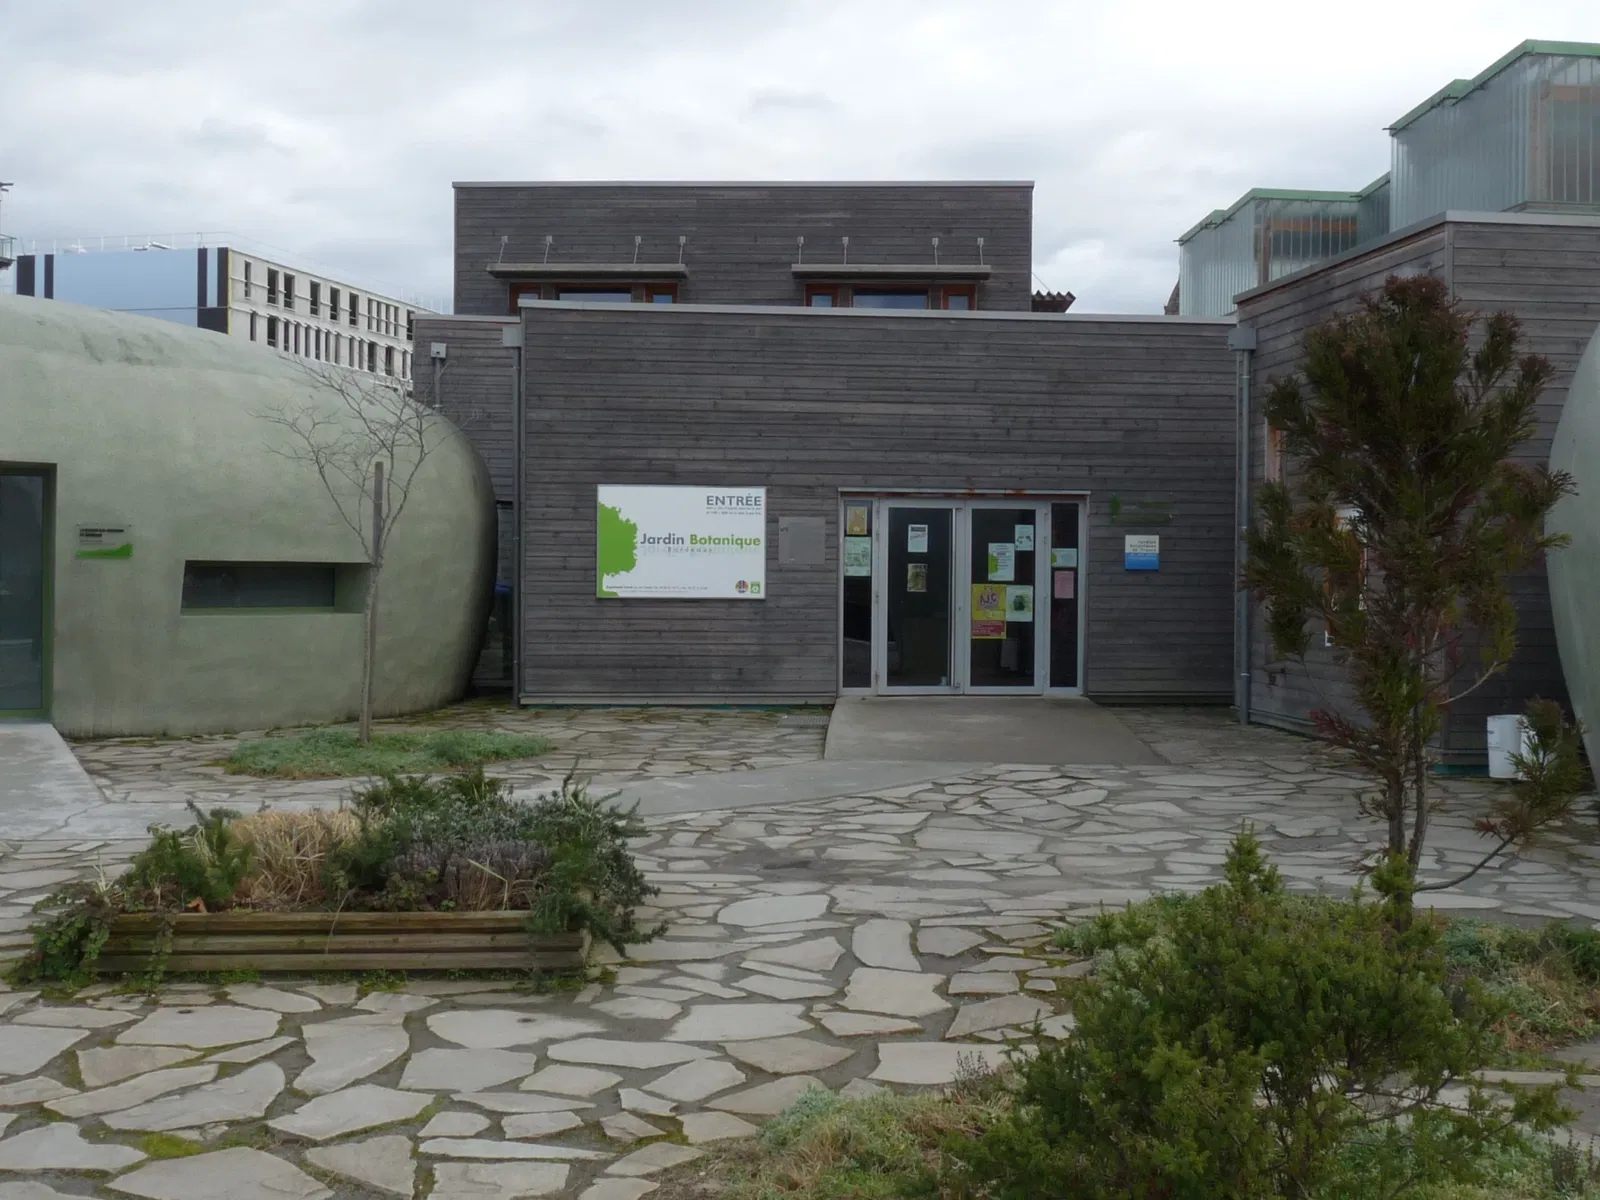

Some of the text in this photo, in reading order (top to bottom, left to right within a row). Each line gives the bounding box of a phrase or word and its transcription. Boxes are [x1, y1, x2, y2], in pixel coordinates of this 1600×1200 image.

[706, 493, 762, 506] ENTRÉE
[640, 533, 761, 549] Jardin Botanique
